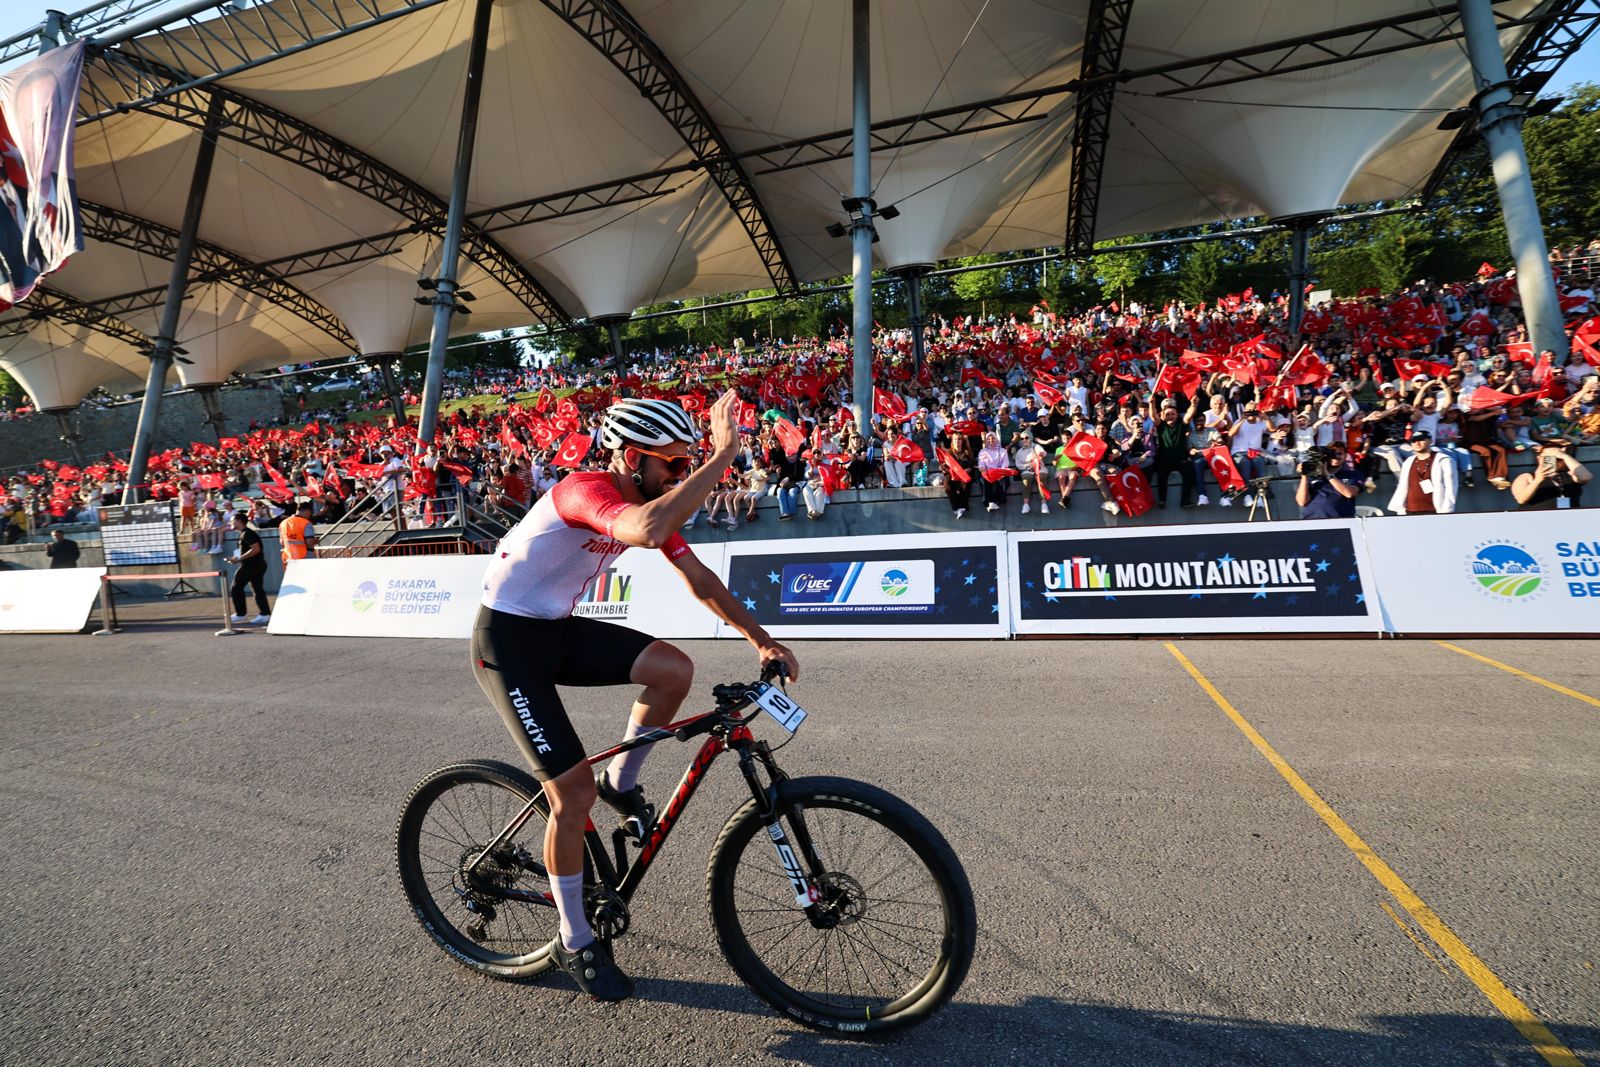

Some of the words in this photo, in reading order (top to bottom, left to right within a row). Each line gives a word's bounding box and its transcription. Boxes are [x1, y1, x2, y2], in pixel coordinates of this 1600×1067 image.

[637, 419, 663, 436] LAZER
[581, 538, 629, 556] TÜRKİY
[671, 546, 687, 557] TUR
[1043, 557, 1108, 590] CITY
[1115, 558, 1315, 588] MOUNTAINBIKE
[1561, 558, 1600, 577] BÜ
[387, 579, 437, 590] SAKARYA
[587, 567, 632, 602] ITY
[806, 579, 832, 588] UEC
[1567, 582, 1600, 597] BE
[384, 589, 452, 602] BÜYÜKŞEHİR
[381, 602, 441, 615] BELEDİYESİ
[573, 604, 629, 615] OUNTAINBIKE
[768, 694, 791, 715] 10
[508, 687, 552, 754] TÜRKİYE
[837, 1022, 867, 1032] ASPEN
